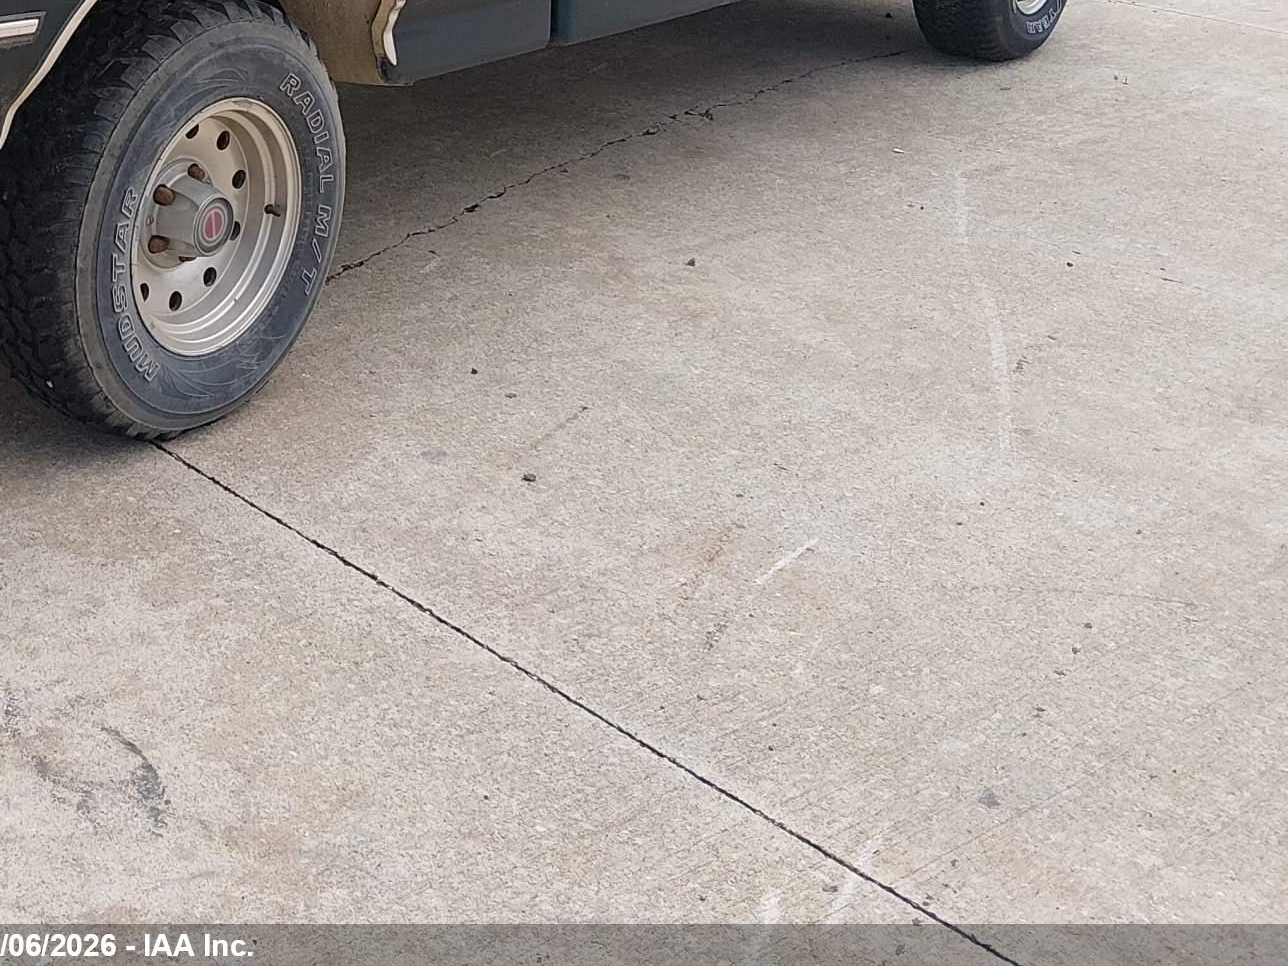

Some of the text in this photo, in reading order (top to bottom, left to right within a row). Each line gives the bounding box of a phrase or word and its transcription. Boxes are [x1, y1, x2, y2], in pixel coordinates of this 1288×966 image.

[112, 186, 160, 383] MUDSTAR
[278, 72, 335, 297] RADIAL M/T
